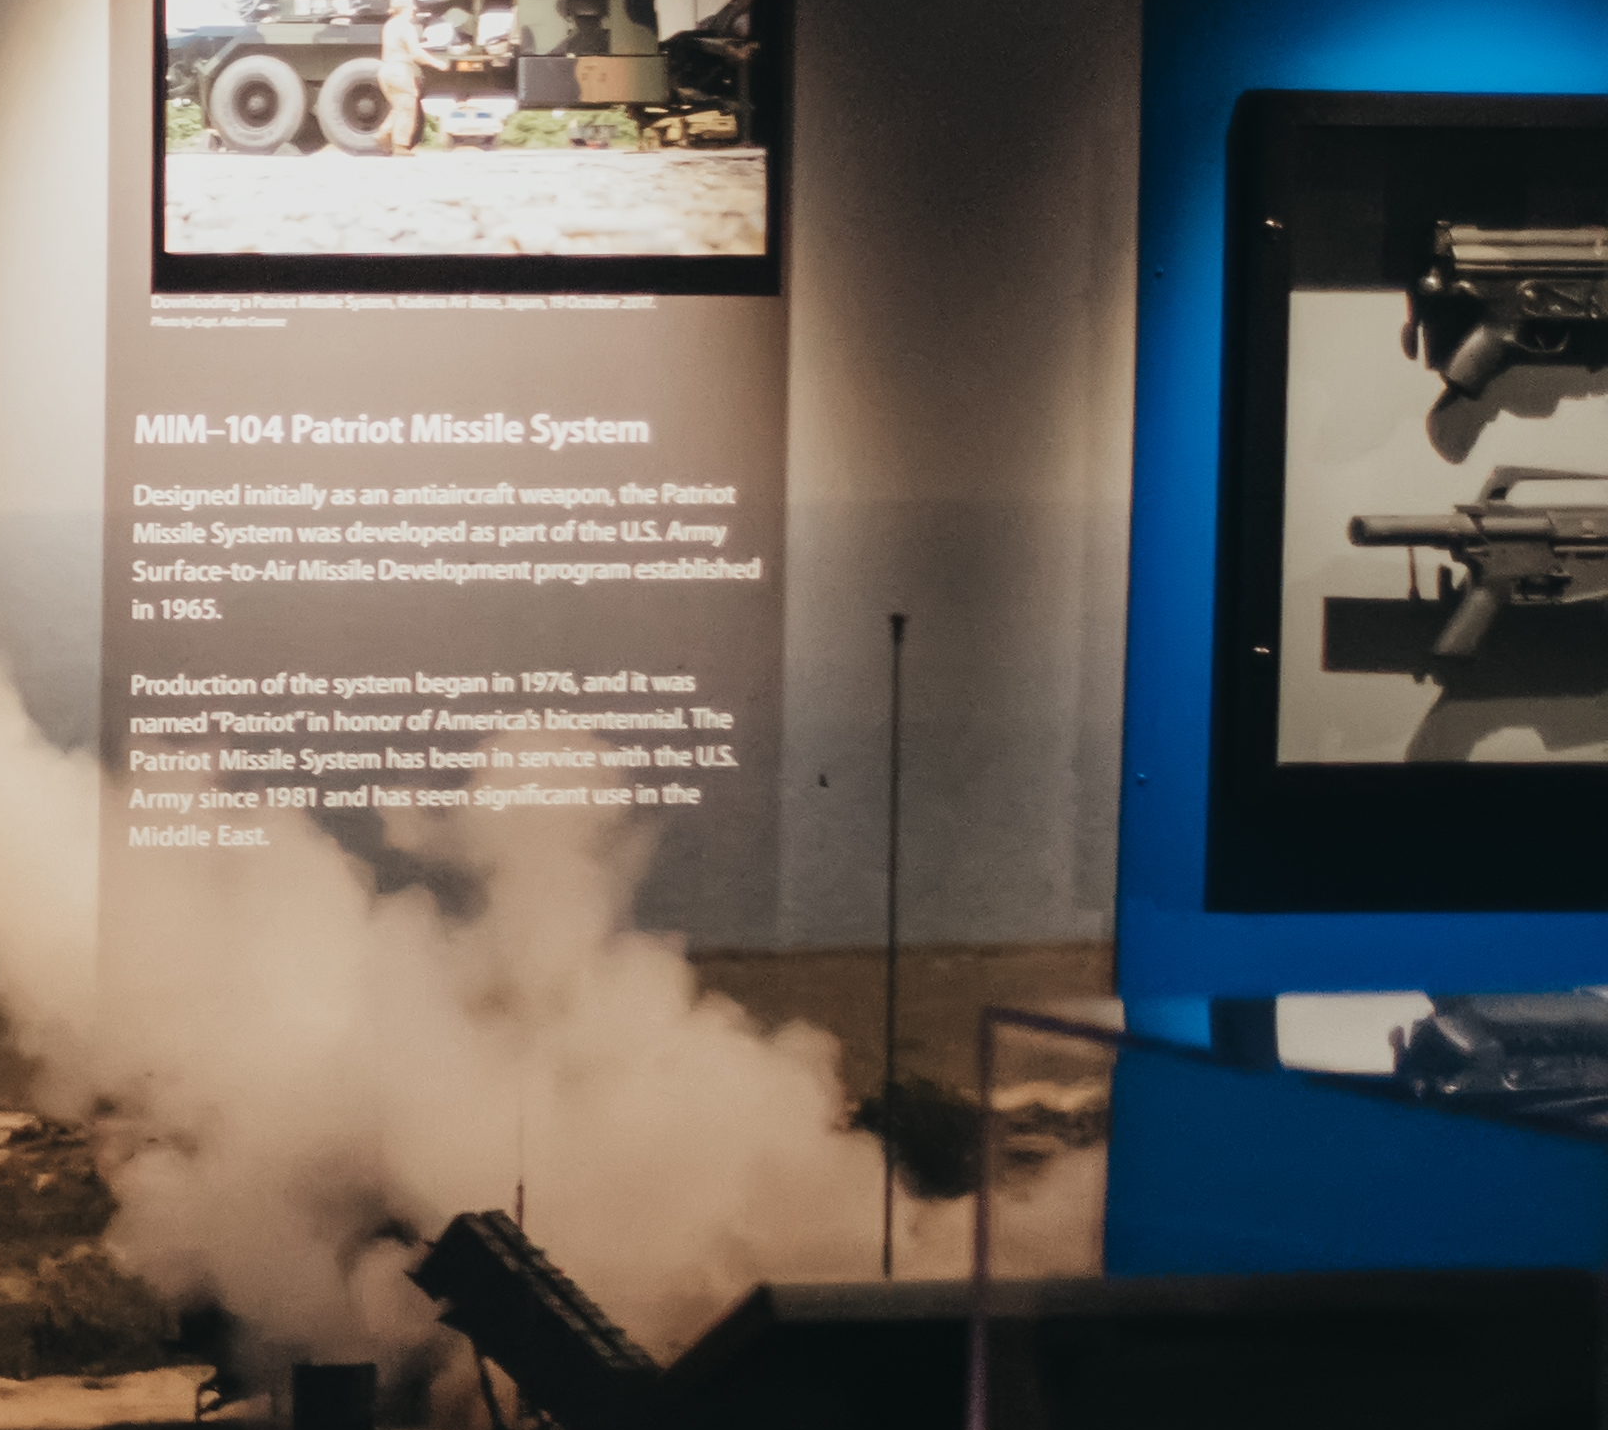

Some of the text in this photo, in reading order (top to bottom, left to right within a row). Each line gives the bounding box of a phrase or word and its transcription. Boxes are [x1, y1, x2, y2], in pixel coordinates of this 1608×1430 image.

[134, 412, 651, 452] MIM–104 Patriot Missile System
[133, 481, 737, 512] Designed initially as an antiaircraft weapon, the Patriot
[131, 597, 223, 621] in 1965.
[128, 824, 270, 848] Middle East.
